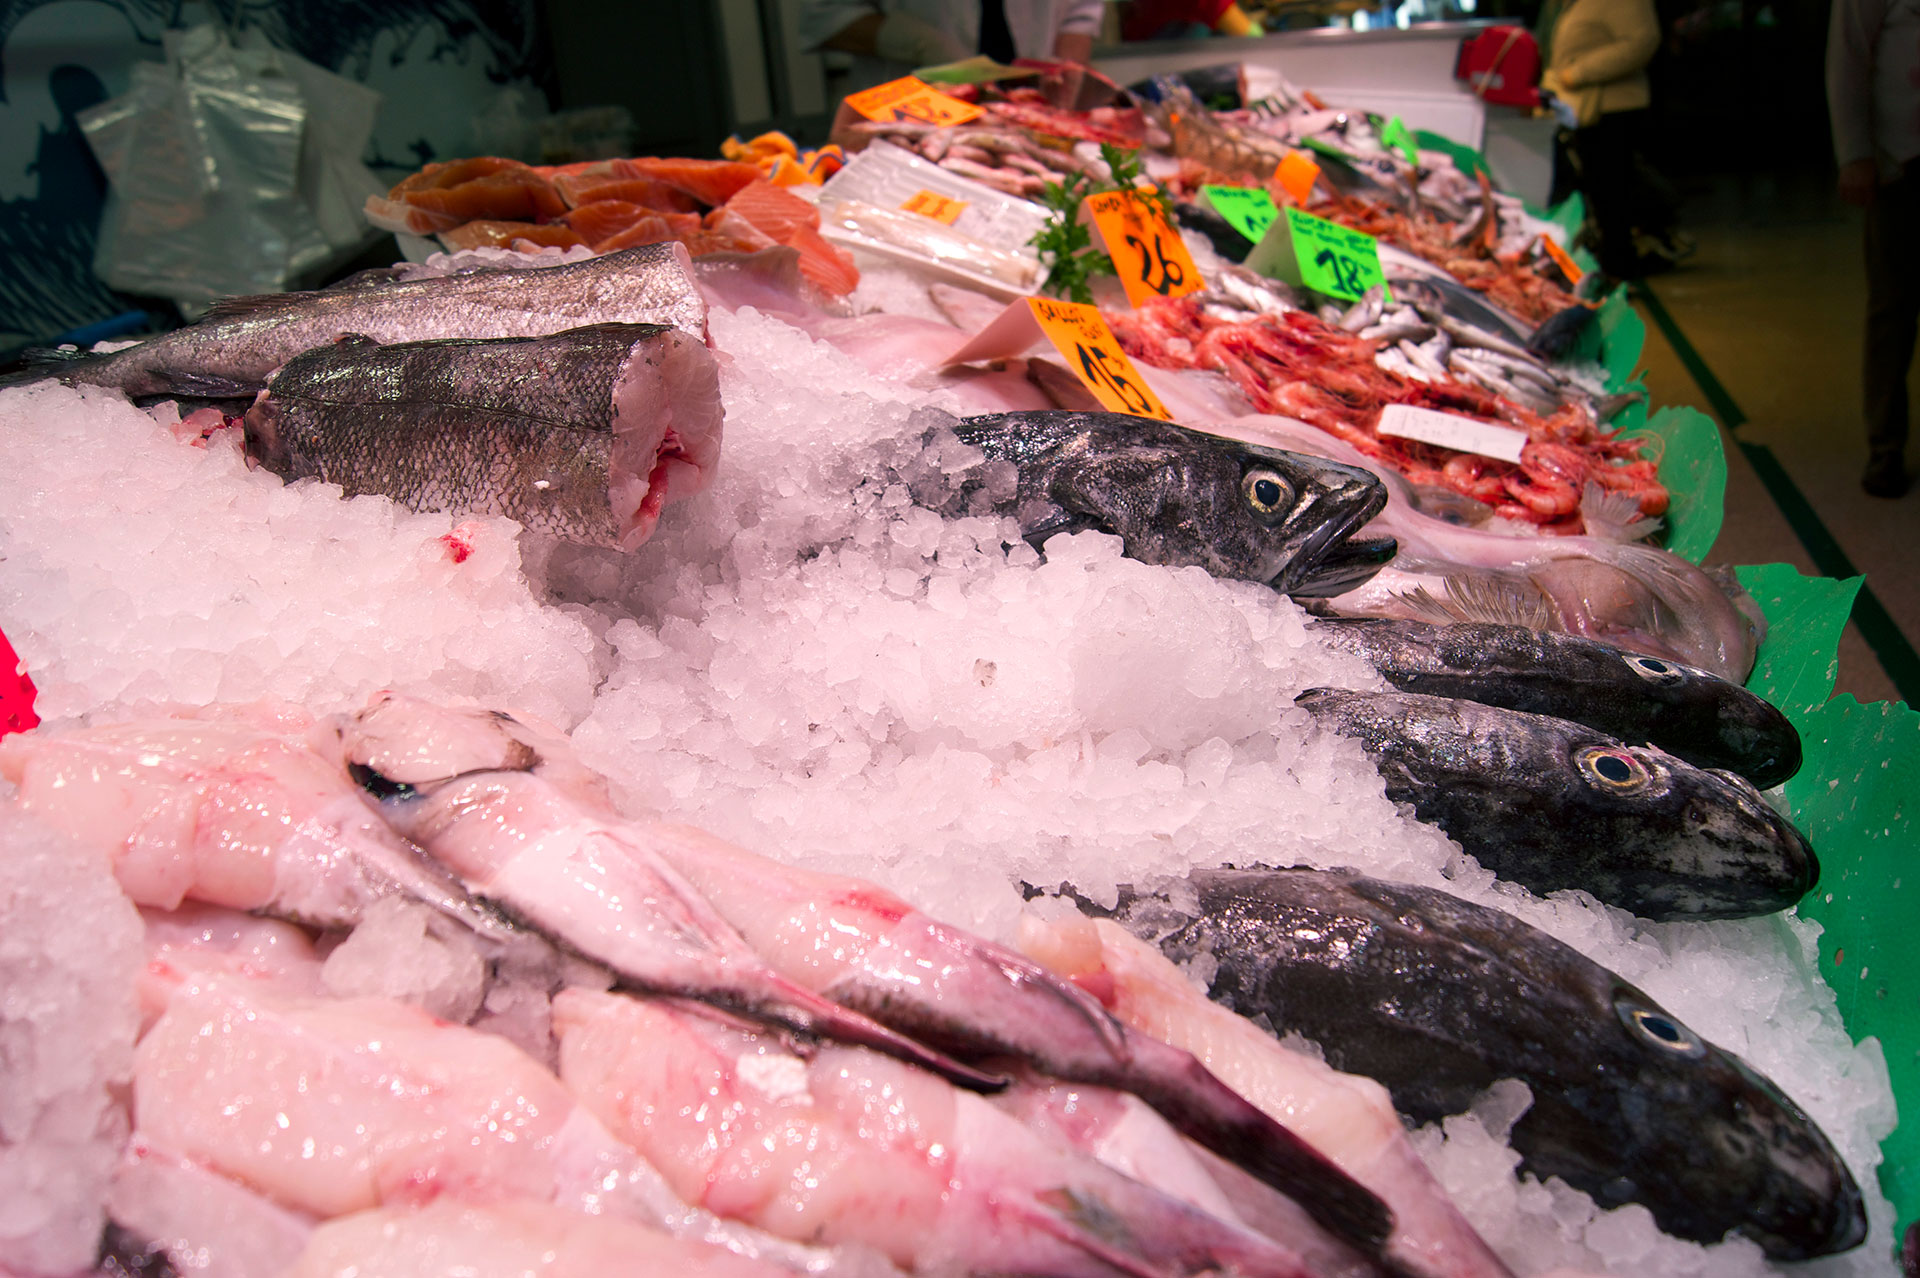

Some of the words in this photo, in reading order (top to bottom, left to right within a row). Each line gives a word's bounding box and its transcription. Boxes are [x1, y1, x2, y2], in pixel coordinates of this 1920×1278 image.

[1125, 233, 1184, 296] 26
[1315, 248, 1366, 298] 18
[1075, 341, 1154, 414] 15
